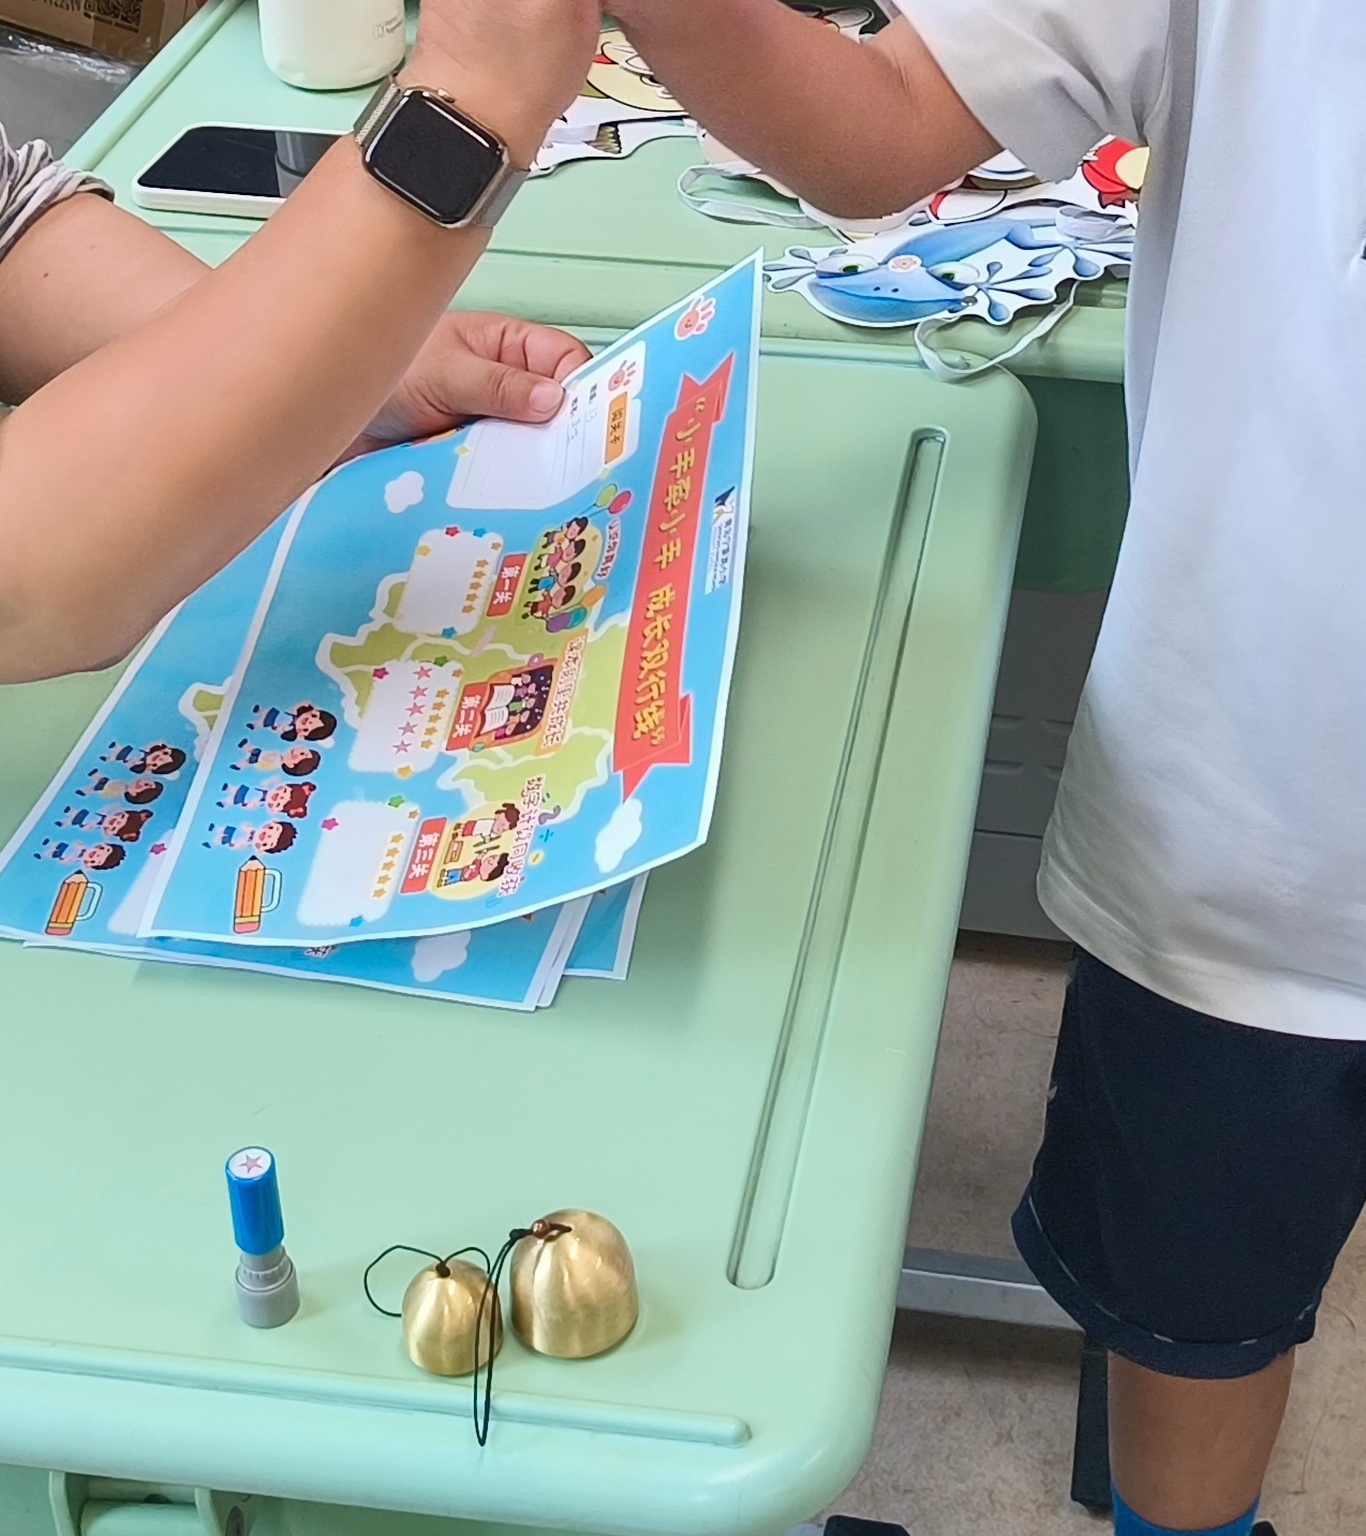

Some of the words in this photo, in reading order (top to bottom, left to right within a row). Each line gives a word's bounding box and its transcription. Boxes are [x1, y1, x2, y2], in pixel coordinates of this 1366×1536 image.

[493, 565, 520, 605] 第一关
[452, 694, 481, 738] 第二关
[408, 831, 439, 879] 第三关
